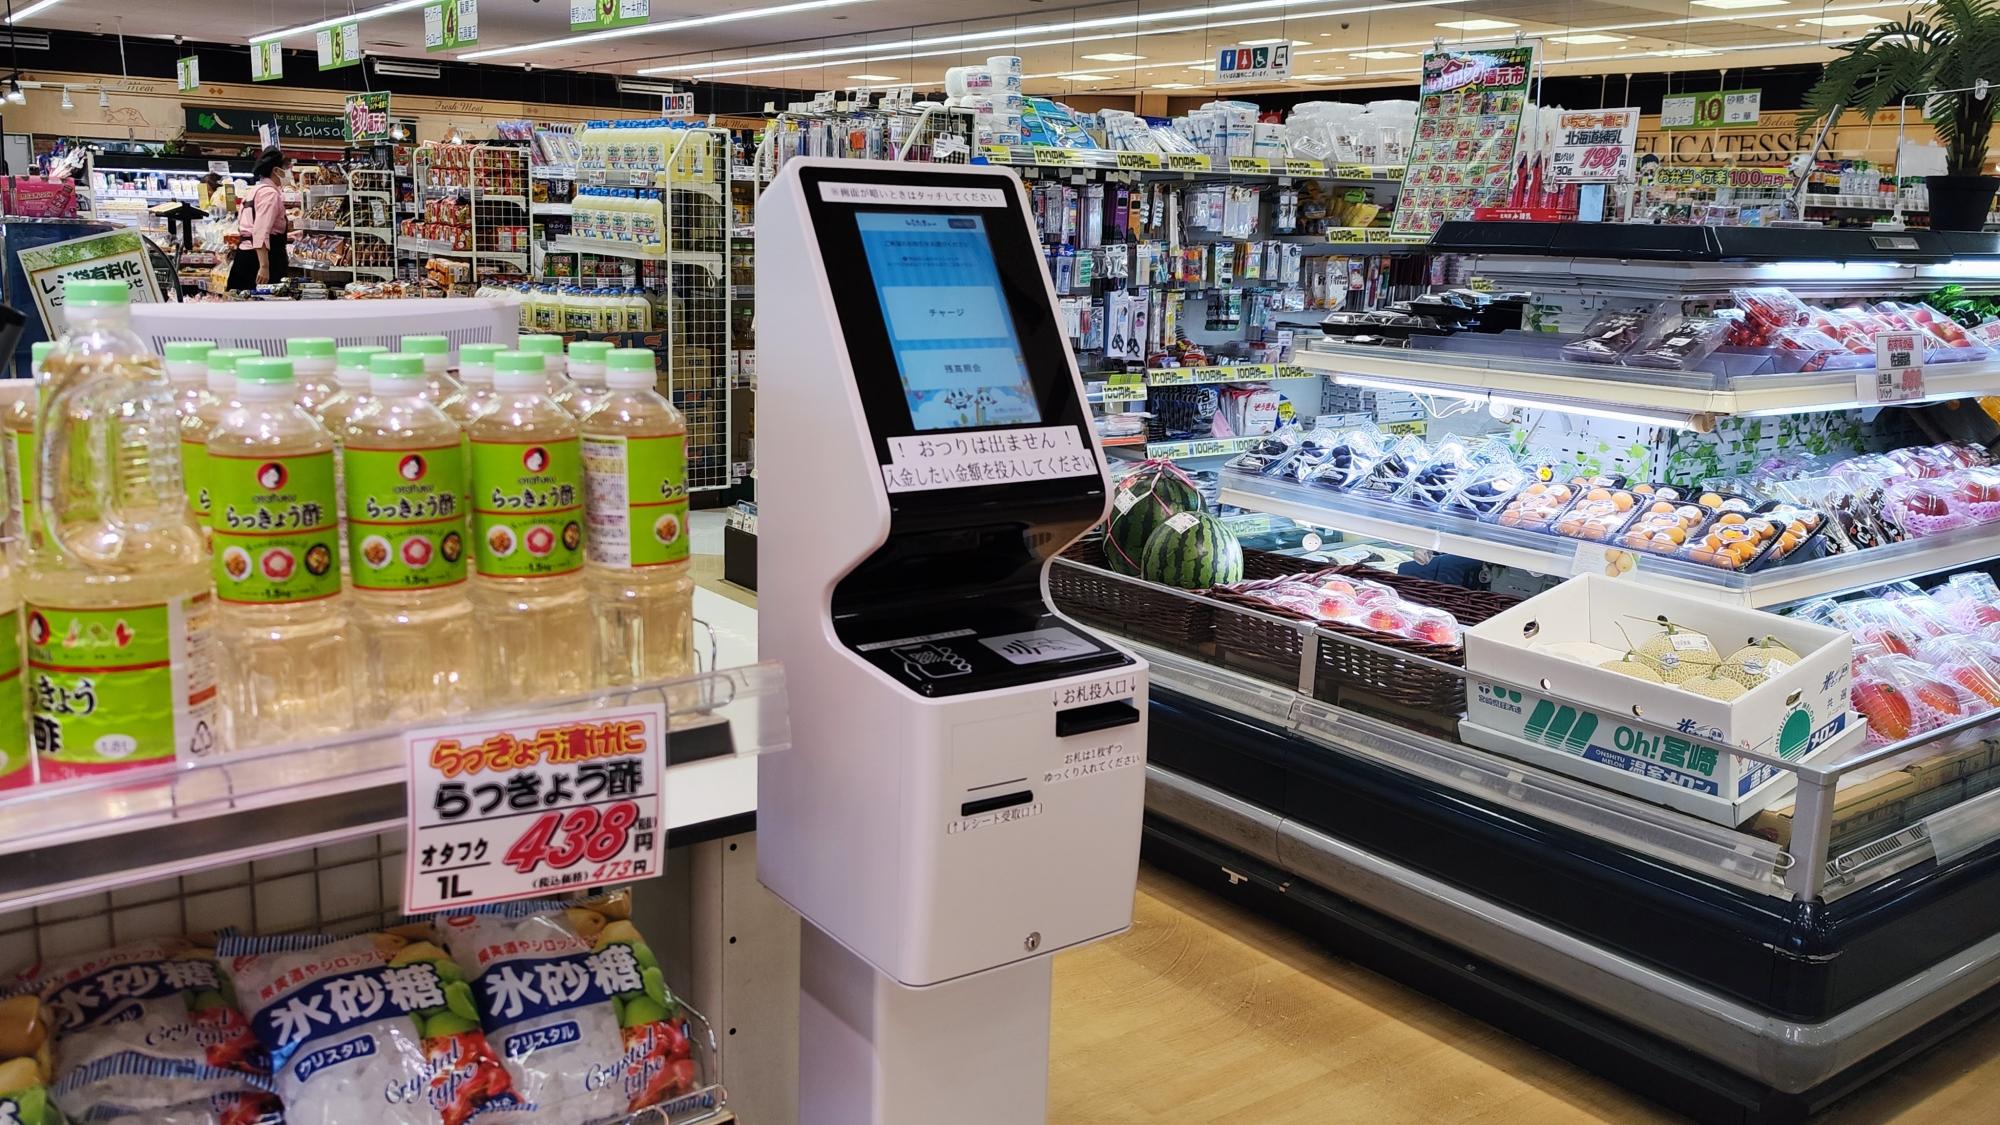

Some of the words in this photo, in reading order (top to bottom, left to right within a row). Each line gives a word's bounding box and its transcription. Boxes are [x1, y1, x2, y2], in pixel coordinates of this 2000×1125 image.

[447, 6, 454, 38] 4
[335, 31, 340, 58] 5
[264, 47, 268, 72] 6
[1701, 98, 1722, 121] 10
[1727, 95, 1758, 104] 砂糖・塩
[286, 114, 310, 122] natural
[1580, 146, 1622, 169] 198
[928, 308, 965, 317] チャージ
[919, 432, 1056, 457] おつりは出ません
[366, 493, 458, 520] らっきょう酢
[492, 484, 575, 509] らっきょう酢
[226, 503, 323, 528] らっきょう酢
[1063, 680, 1126, 704] お札投入口
[1810, 722, 1839, 748] メロン
[431, 720, 647, 778] らっきょう漬けに
[1595, 748, 1626, 763] ONSHITU
[1601, 757, 1625, 769] MELON
[434, 758, 643, 819] らっきょう酢
[502, 800, 639, 873] 438
[634, 832, 654, 853] 円
[422, 838, 488, 866] オタフク
[592, 860, 633, 881] 473
[633, 859, 647, 873] 円
[437, 874, 472, 899] 1L
[485, 944, 643, 1018] 氷砂糖
[269, 962, 446, 1046] 氷砂糖
[508, 1024, 576, 1050] クリスタル
[299, 1039, 371, 1076] クリスタル
[585, 1026, 655, 1092] Crystal
[386, 1038, 460, 1103] Crystal
